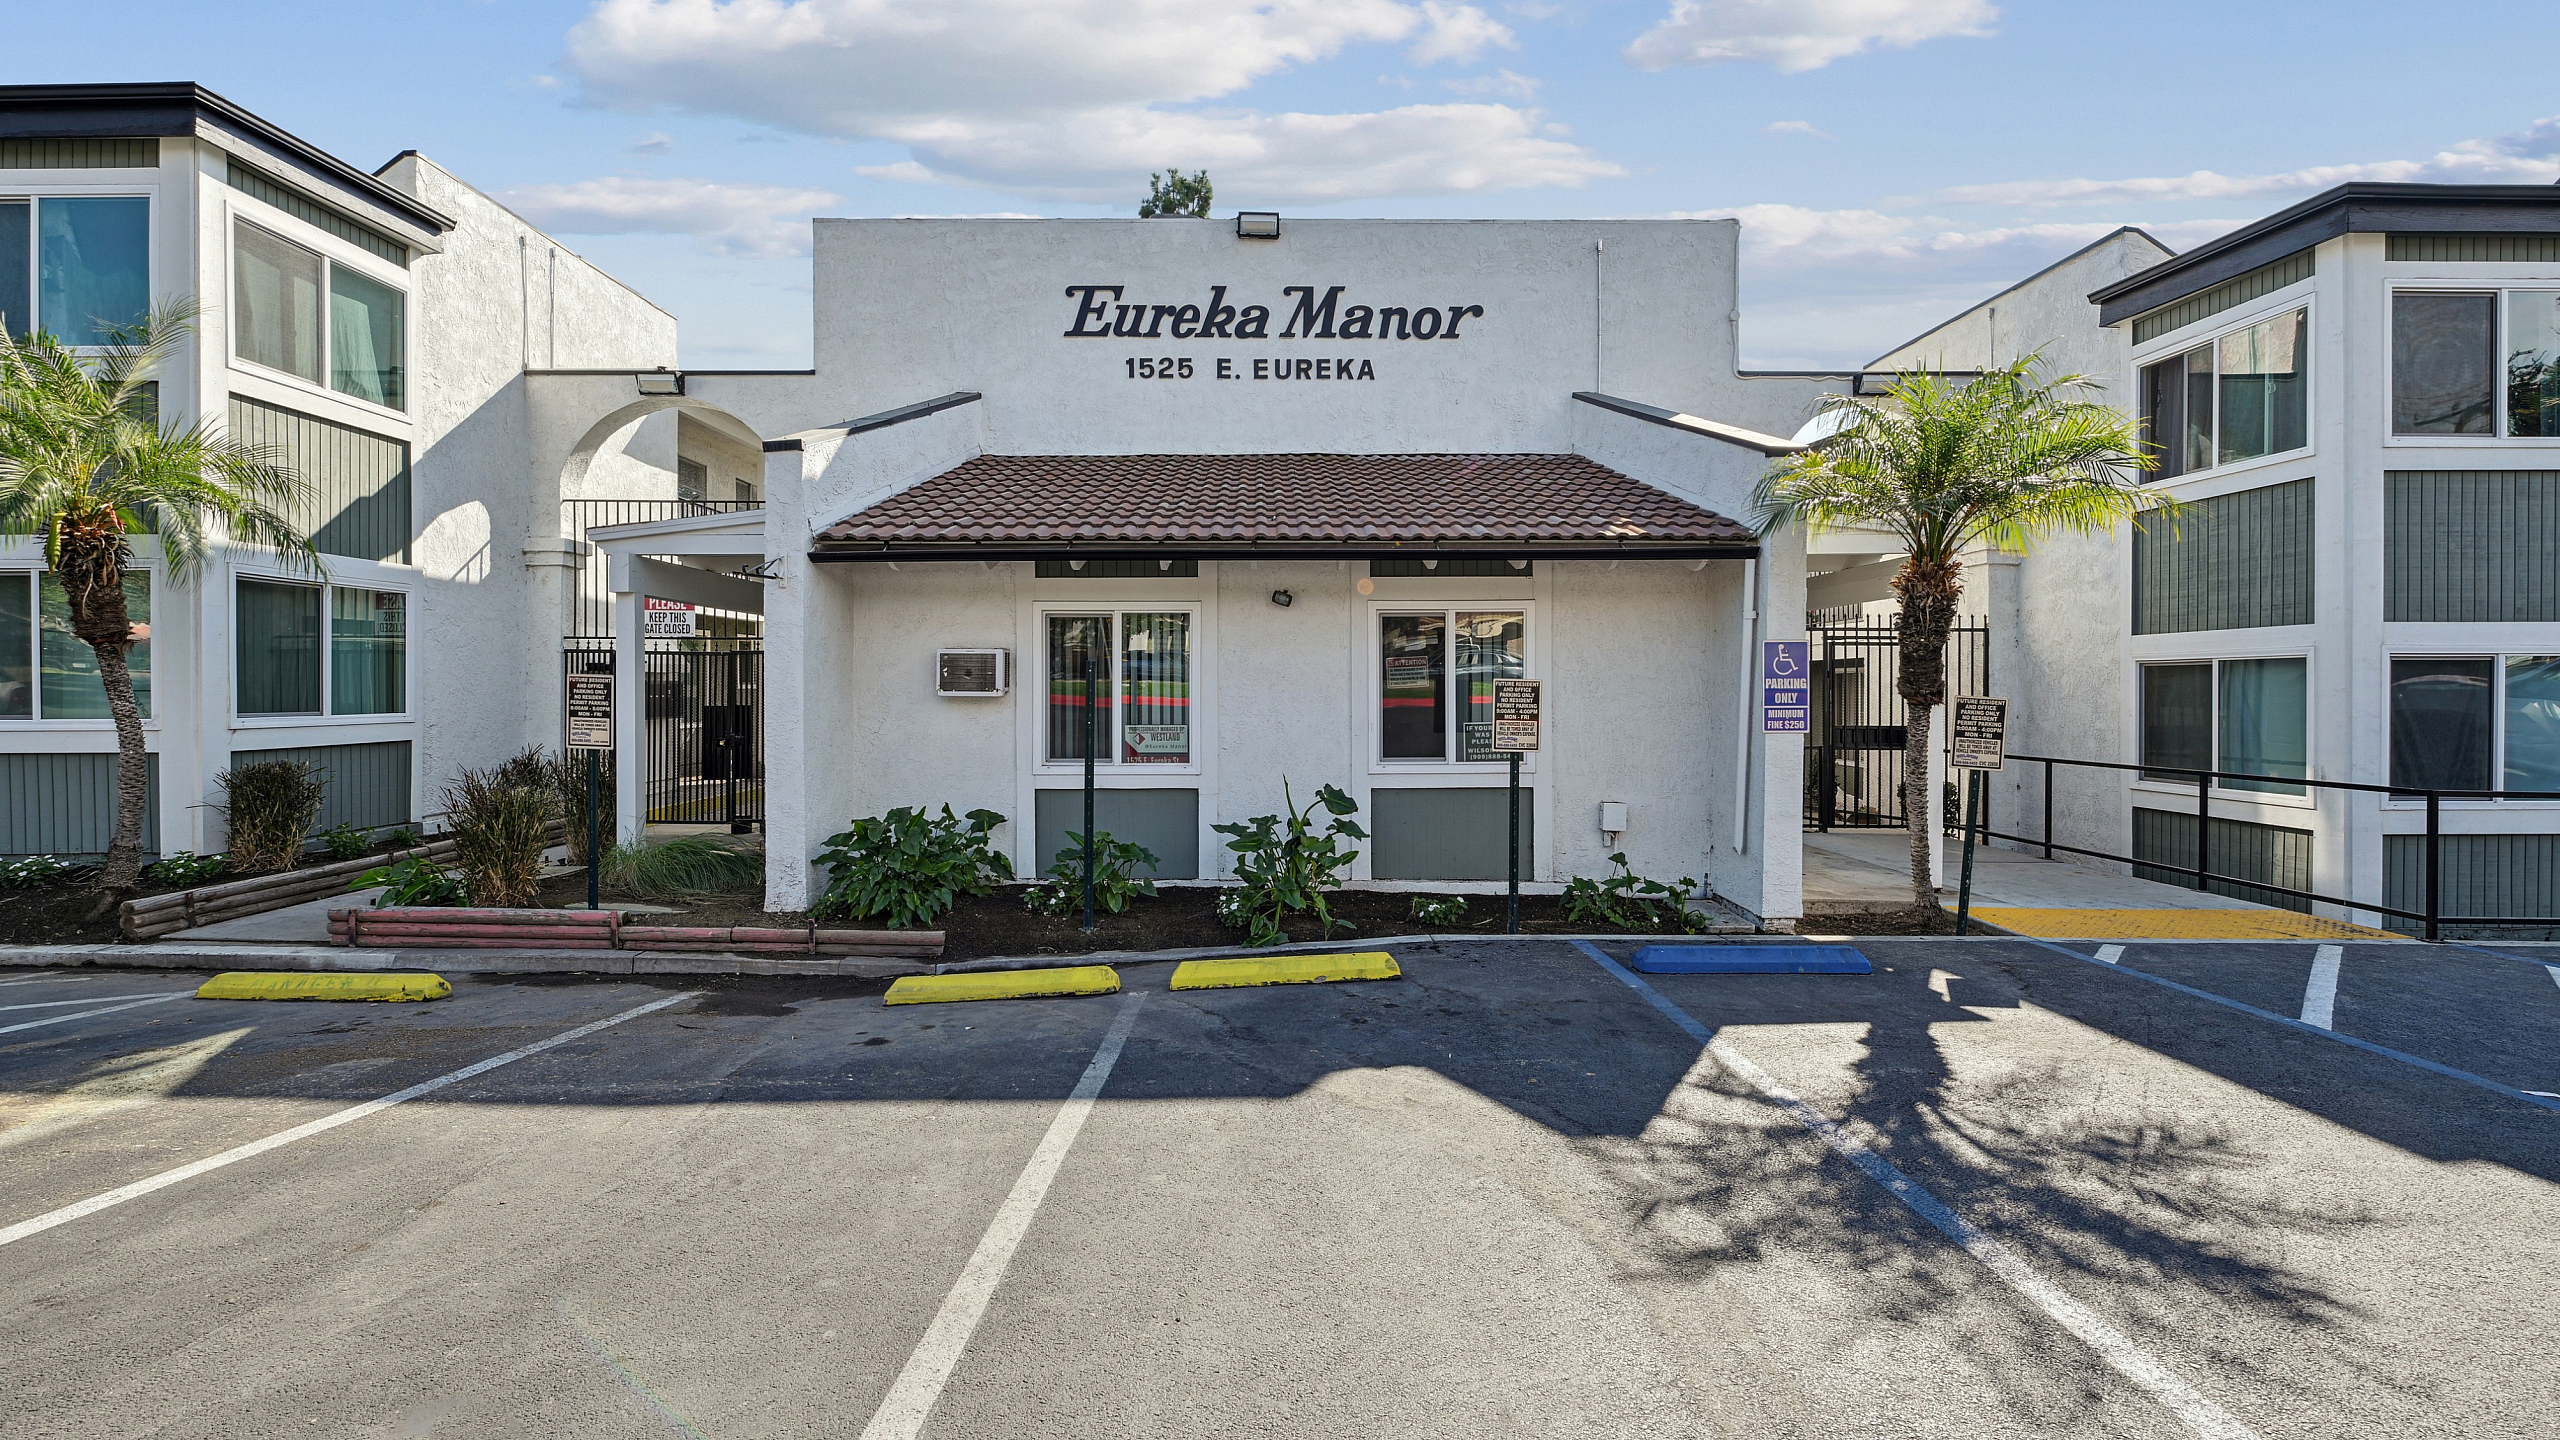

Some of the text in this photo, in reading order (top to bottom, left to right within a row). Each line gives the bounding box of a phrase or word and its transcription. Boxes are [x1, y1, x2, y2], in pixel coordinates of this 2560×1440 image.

[1063, 285, 1483, 339] Eureka Manor
[1126, 358, 1375, 380] 1525 E. EUREKA
[649, 612, 686, 623] KEEP THIS
[645, 624, 690, 634] GATE CLOSED
[1766, 678, 1807, 689] PARKING
[1775, 693, 1798, 703] ONLY
[1785, 720, 1804, 729] $250
[1151, 733, 1180, 741] WESTLAND
